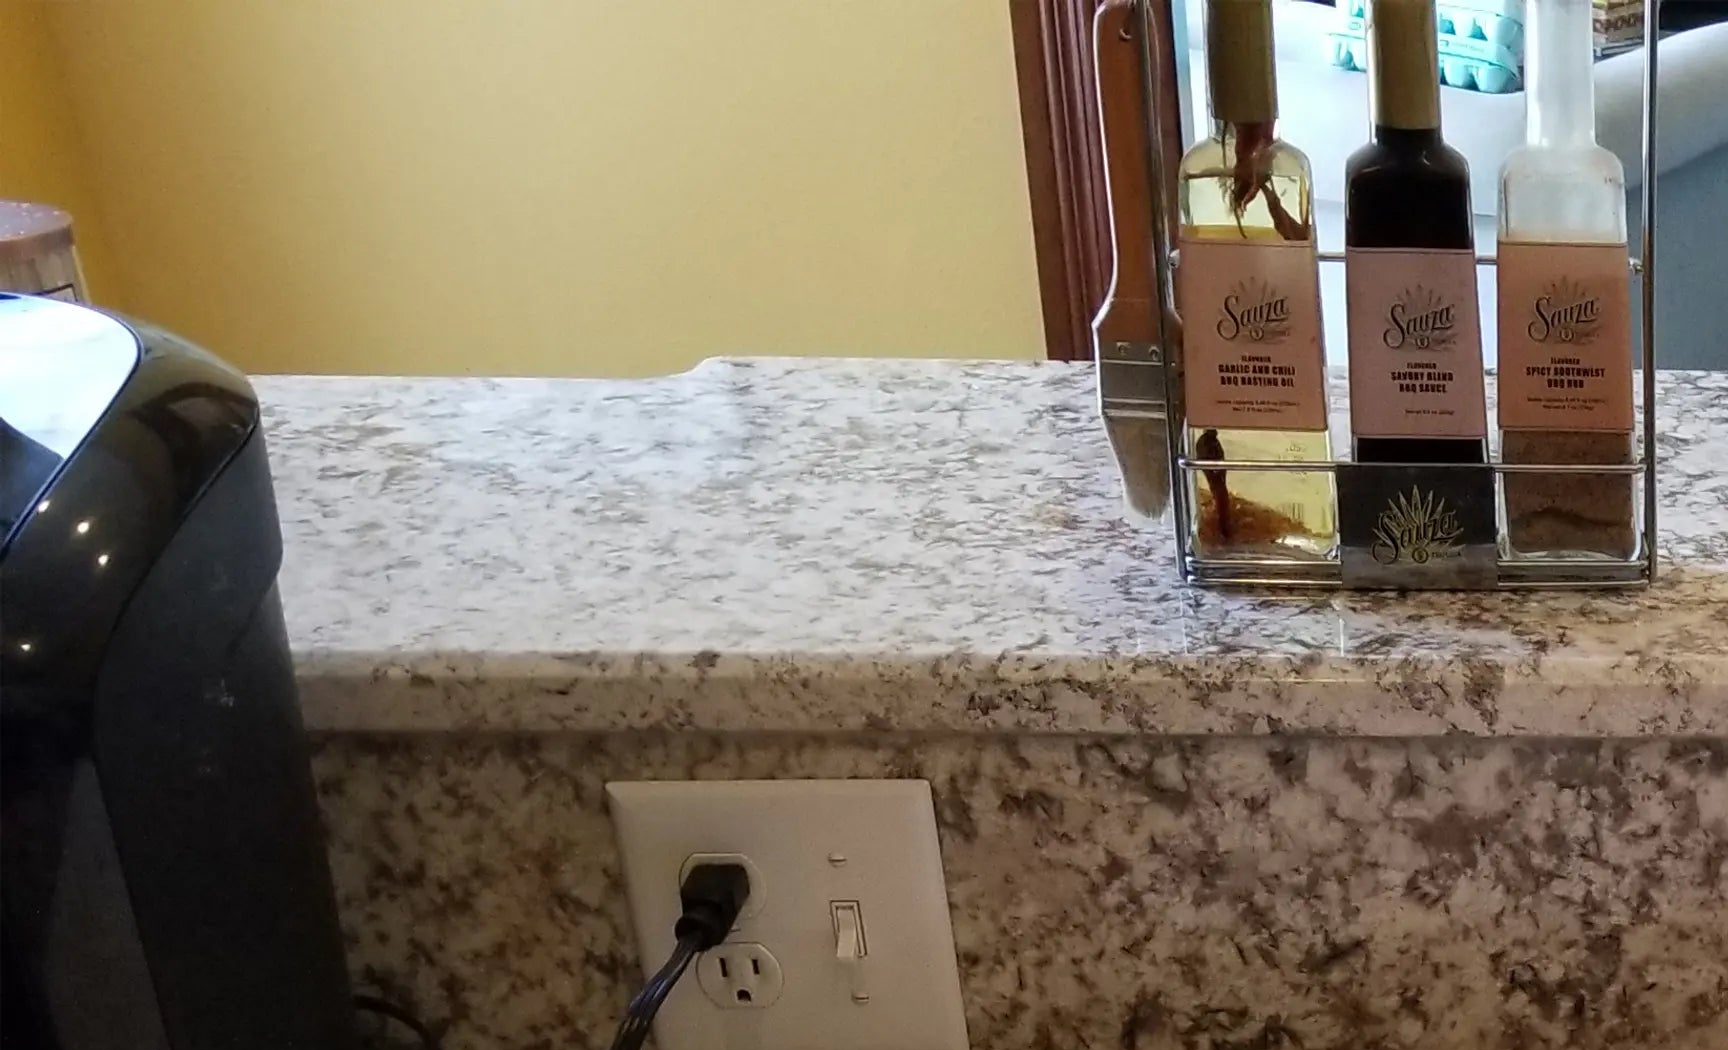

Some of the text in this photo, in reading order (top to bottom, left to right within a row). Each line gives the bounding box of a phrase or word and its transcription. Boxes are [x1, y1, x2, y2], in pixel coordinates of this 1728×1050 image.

[1217, 294, 1290, 340] Sauza
[1527, 296, 1599, 343] Sauza
[1383, 303, 1455, 349] Sauza
[1218, 364, 1296, 376] GARLIC AND CHILI
[1526, 366, 1605, 378] SPICY SOUTHWEST
[1220, 376, 1295, 388] BBQ BASTING OIL
[1391, 371, 1454, 382] SAVORY BLEND
[1399, 383, 1447, 393] BBQ SAUCE
[1547, 378, 1584, 389] BBQ RUB
[1372, 510, 1460, 565] Sauza
